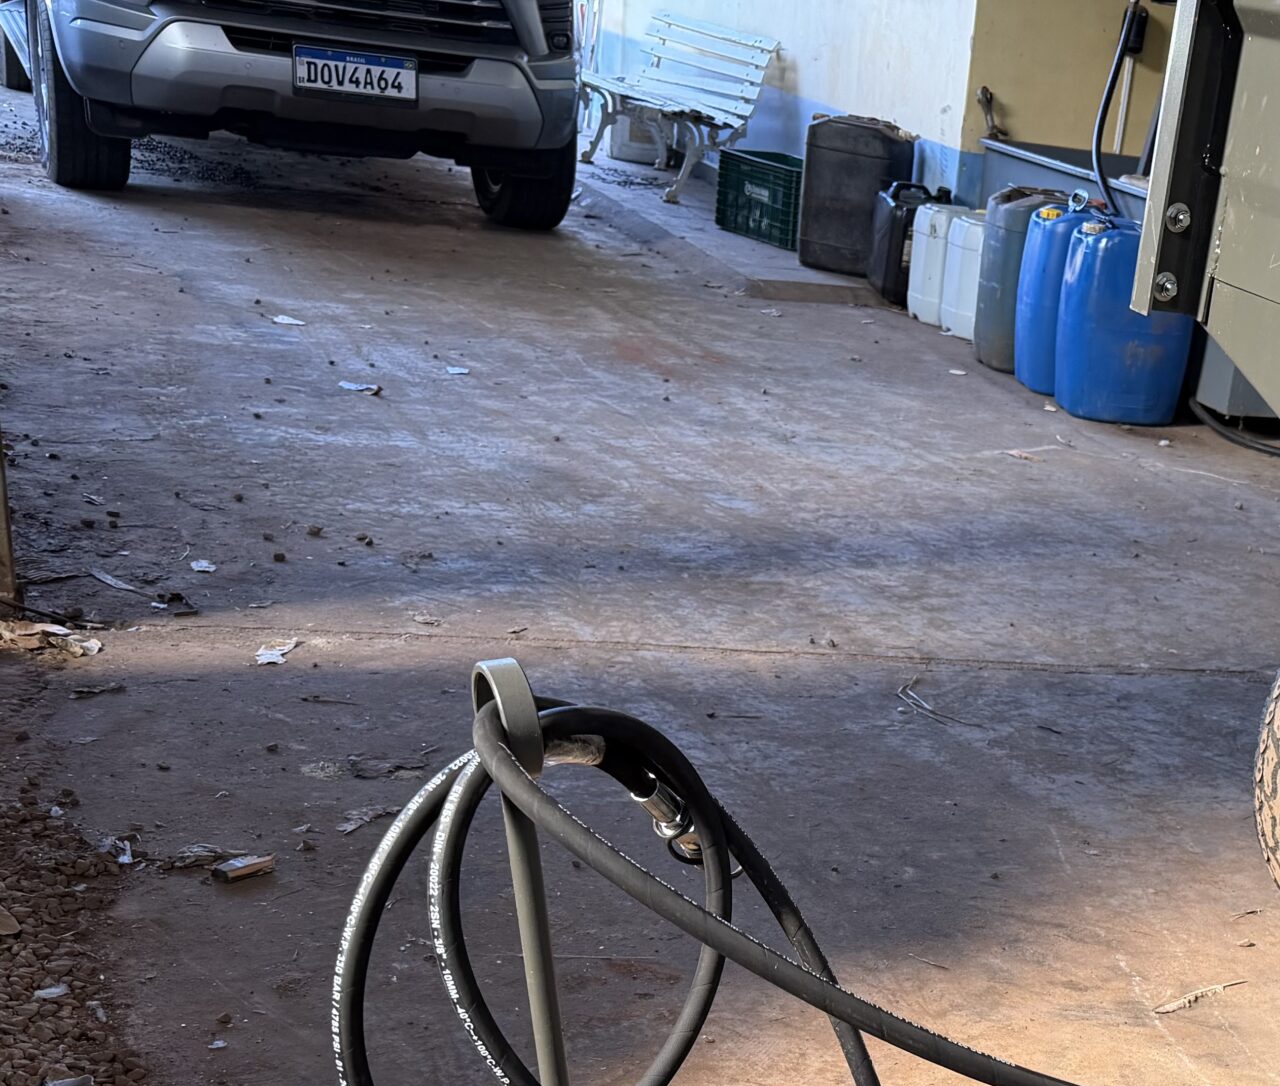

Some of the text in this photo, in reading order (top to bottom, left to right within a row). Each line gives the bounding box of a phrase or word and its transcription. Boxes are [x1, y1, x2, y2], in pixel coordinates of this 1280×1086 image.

[305, 60, 403, 94] DOV4A64
[432, 831, 445, 853] DIN
[429, 861, 440, 896] 20022
[430, 905, 441, 928] 2SN
